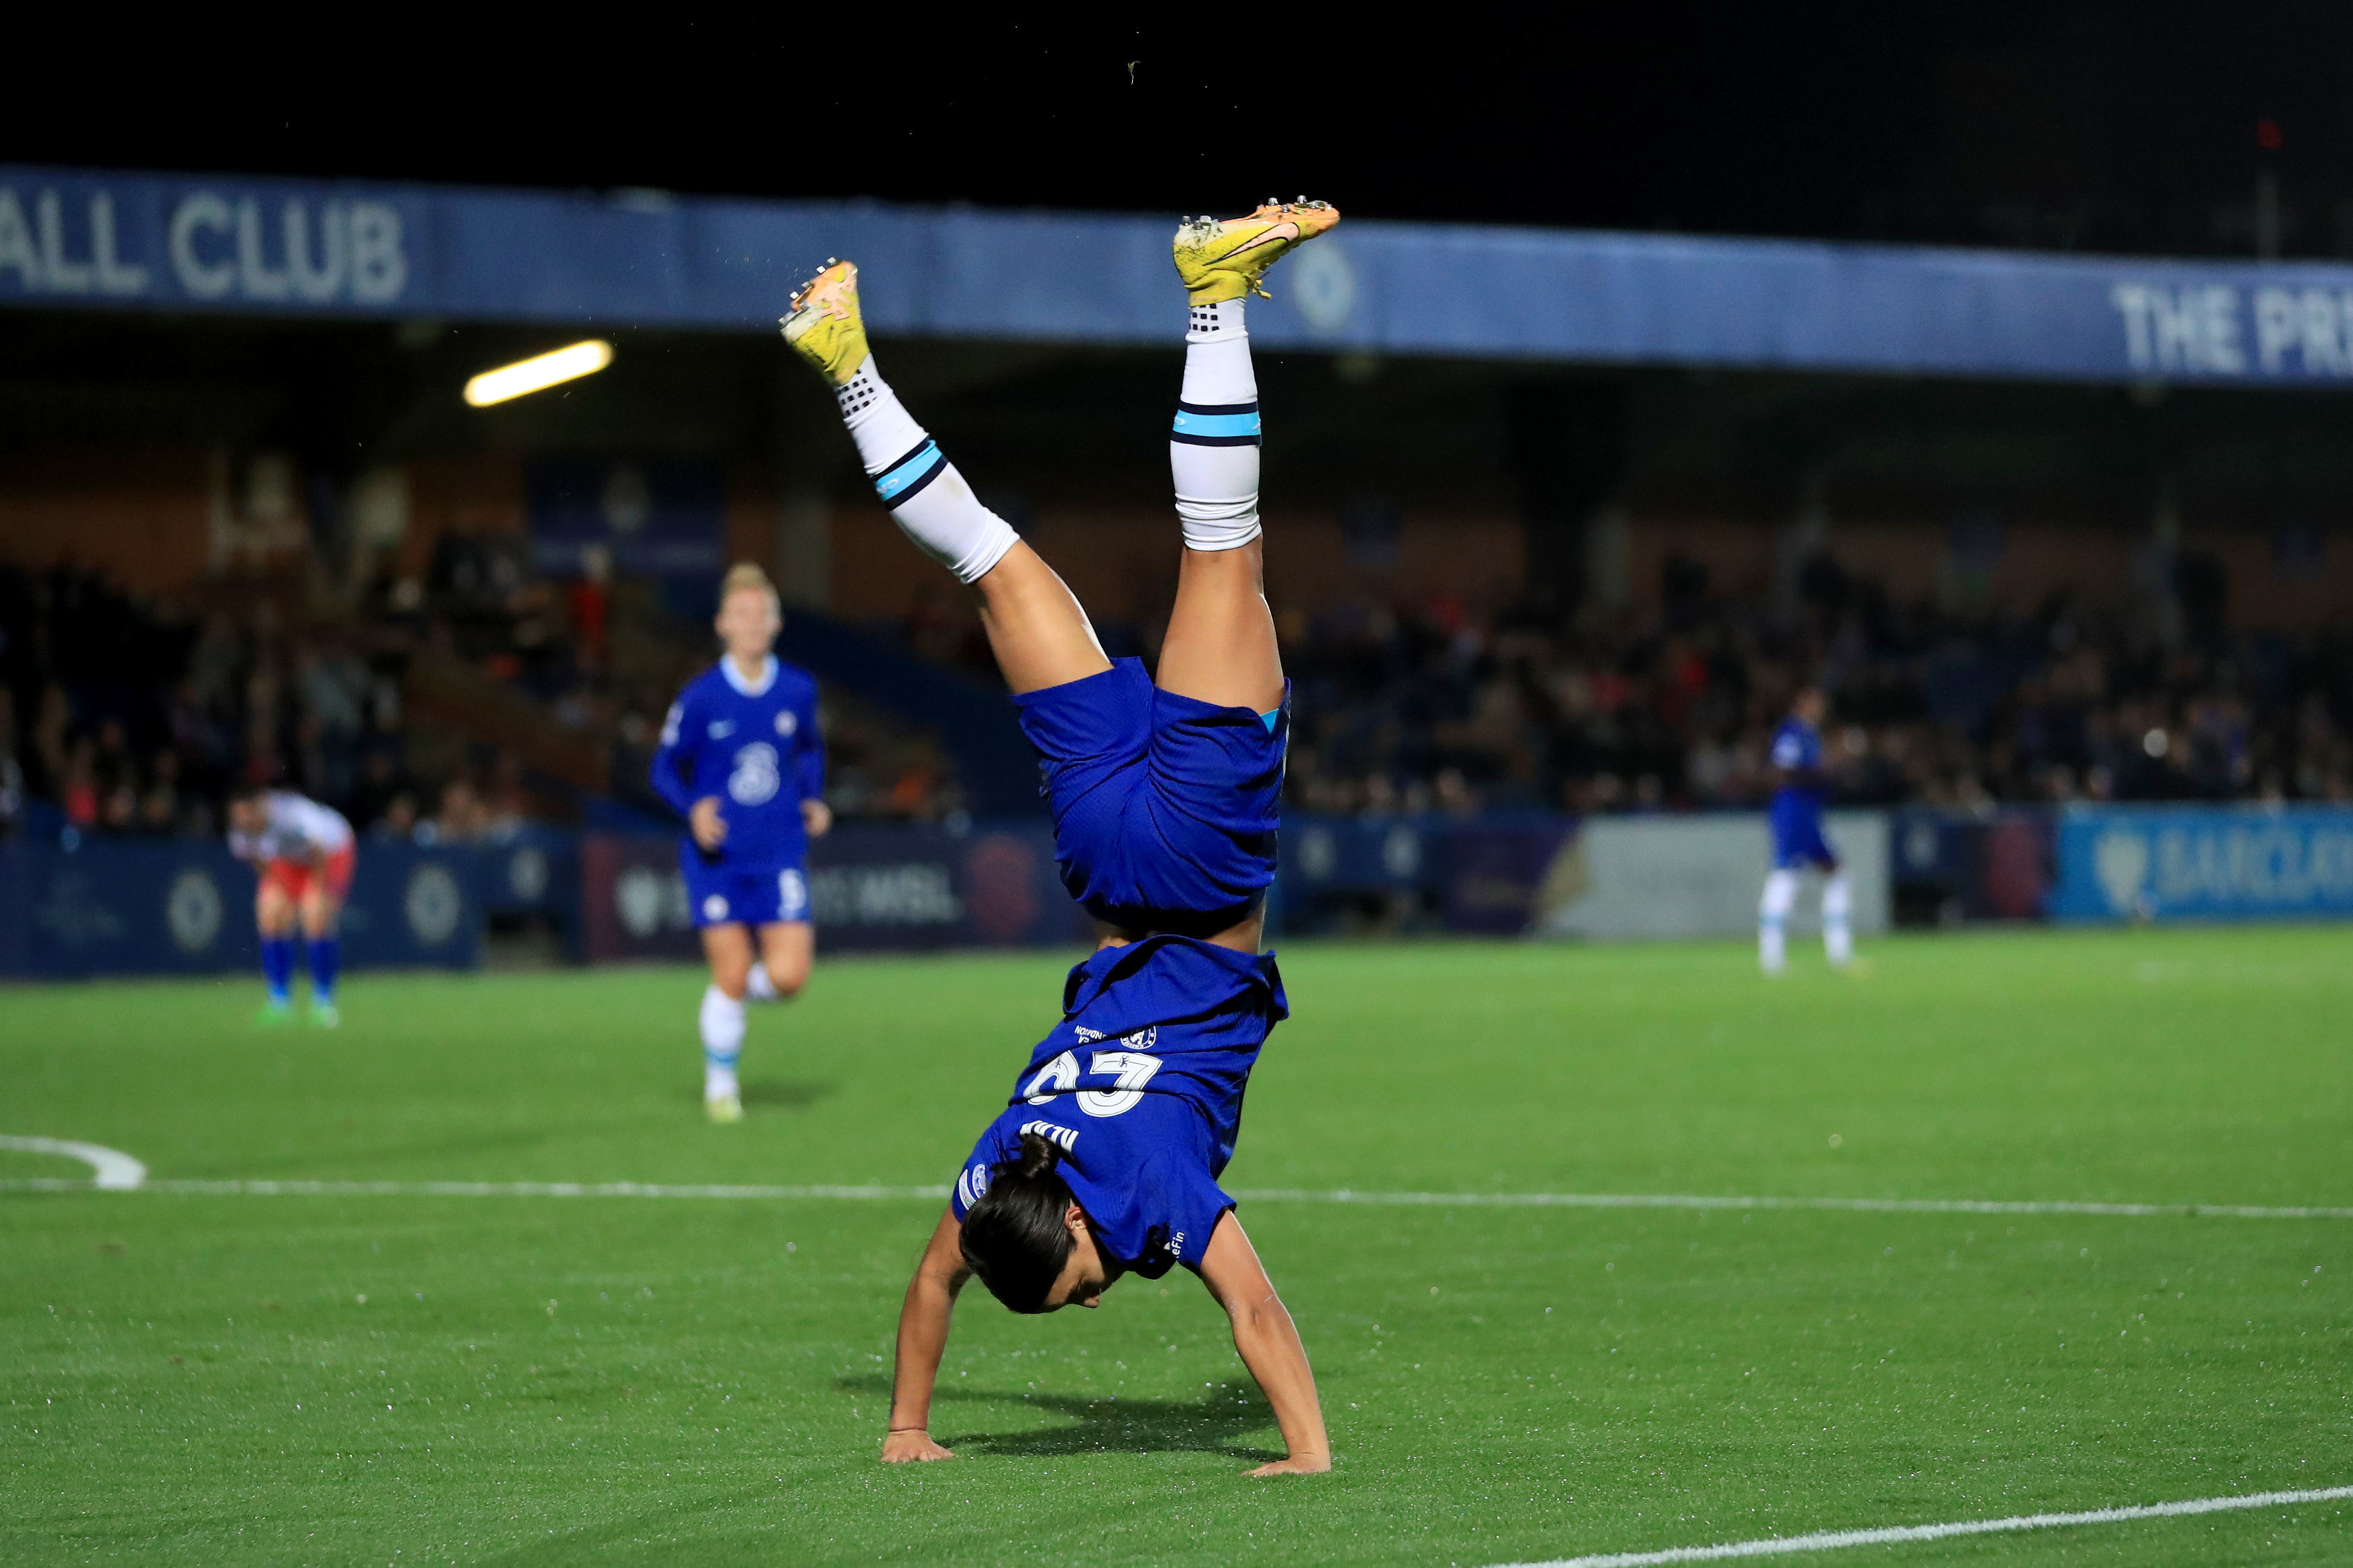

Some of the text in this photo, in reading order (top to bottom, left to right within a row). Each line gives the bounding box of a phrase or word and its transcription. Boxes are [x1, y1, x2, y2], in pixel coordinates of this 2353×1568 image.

[169, 190, 407, 304] CLUB
[2111, 284, 2244, 374] THE
[1171, 1231, 1185, 1259] eFin
